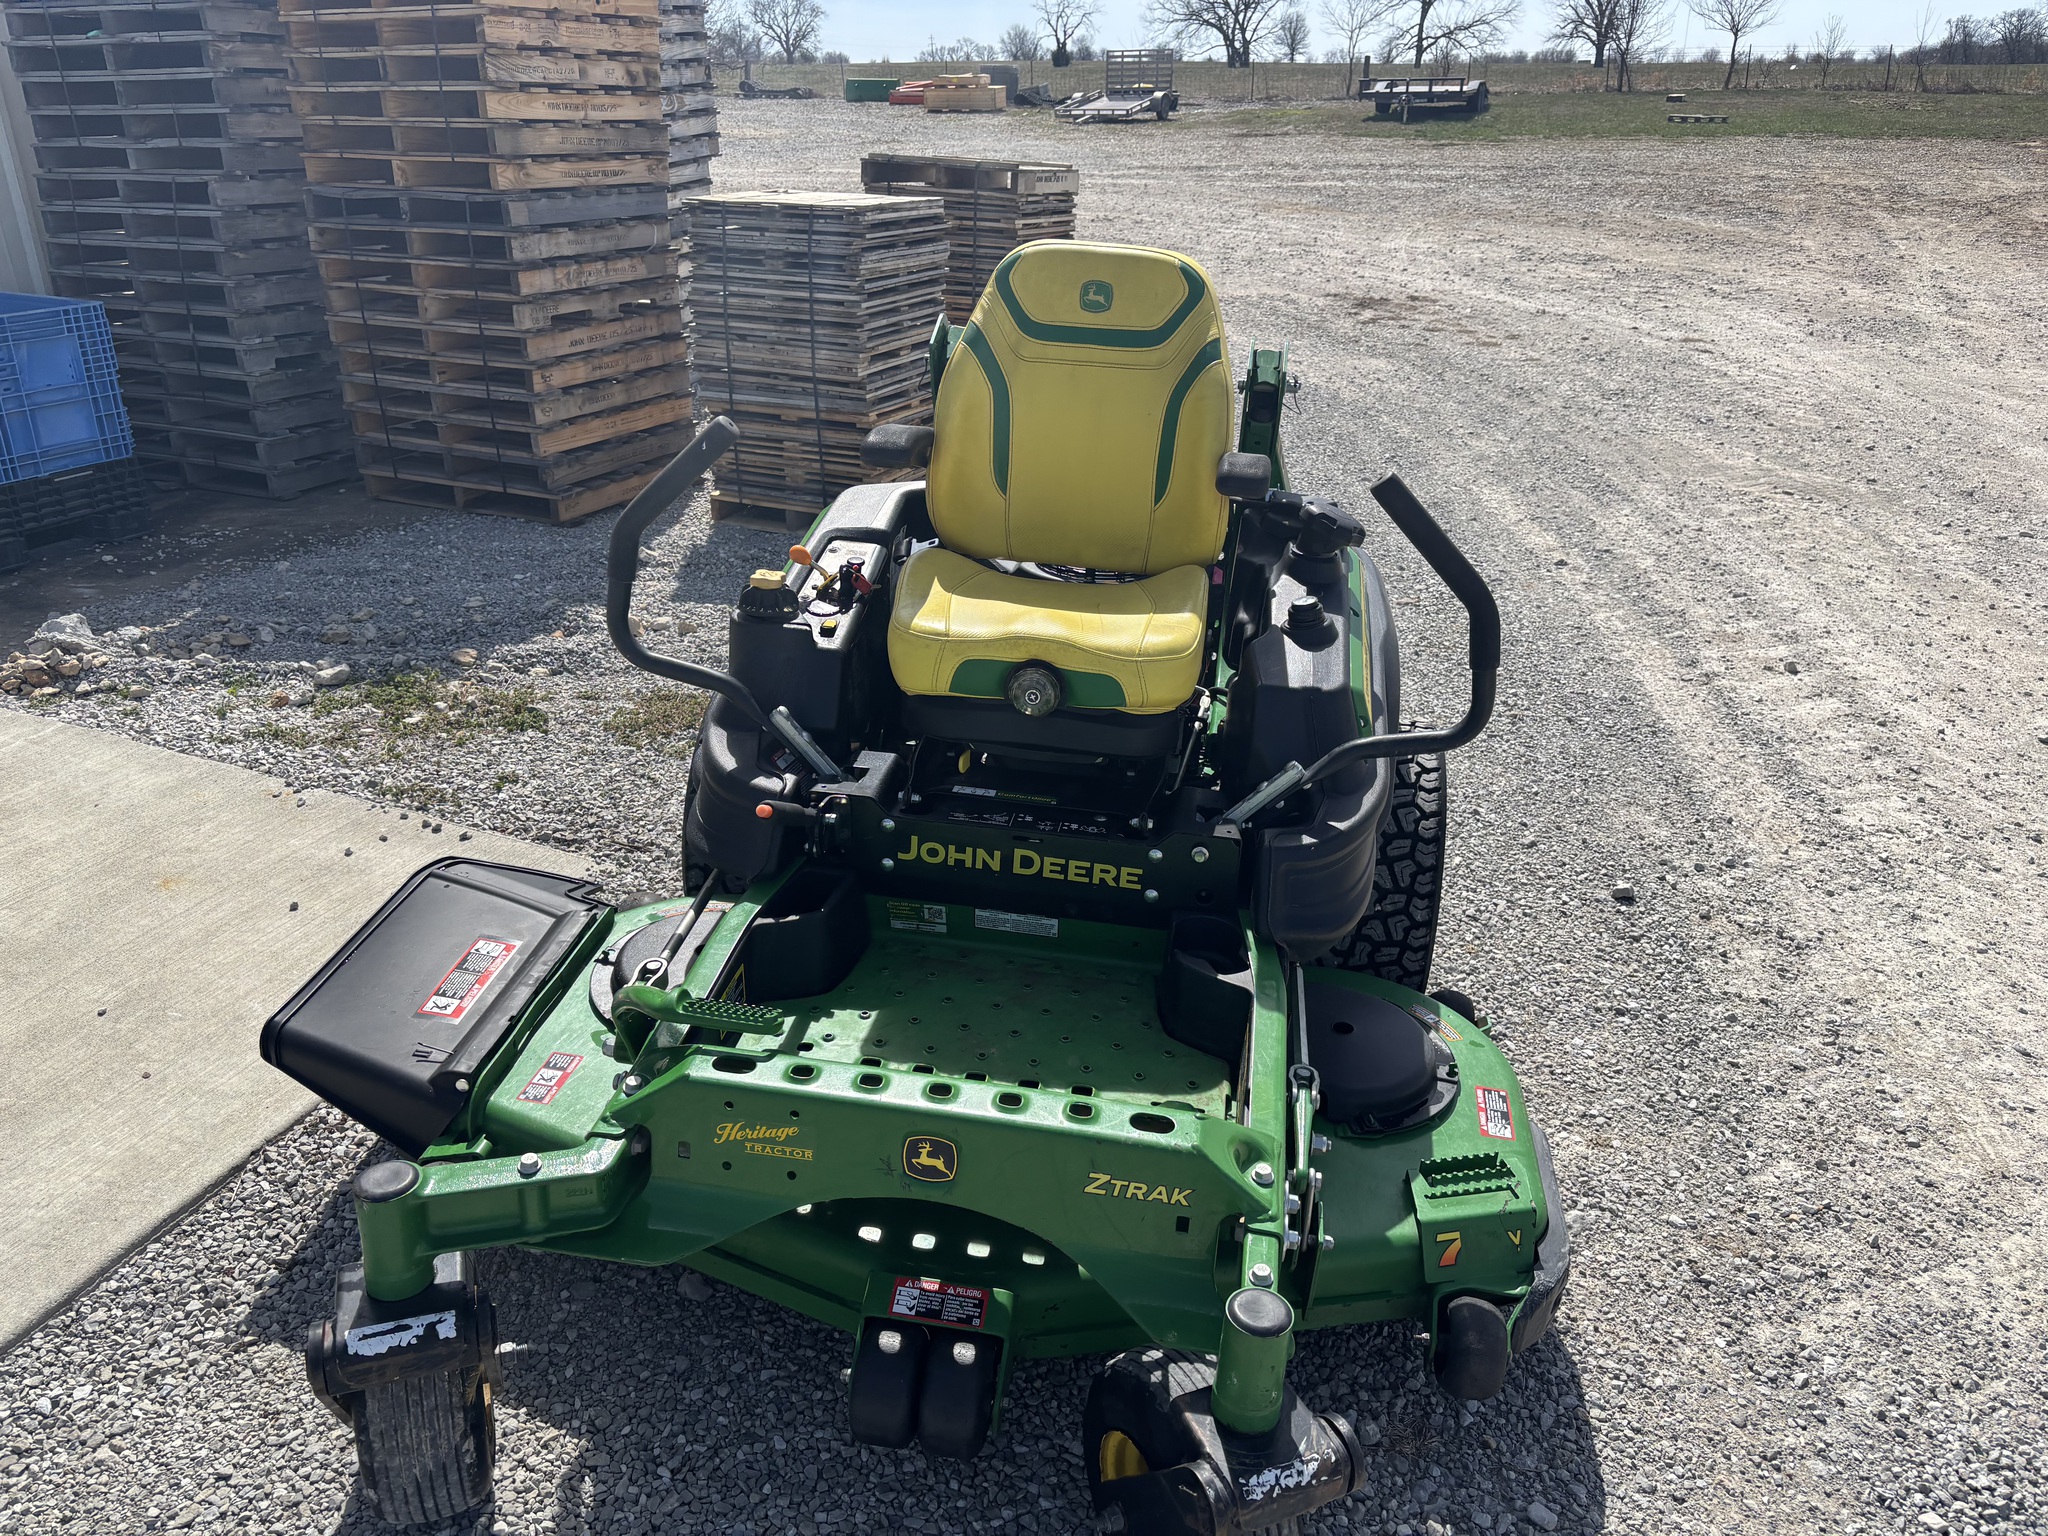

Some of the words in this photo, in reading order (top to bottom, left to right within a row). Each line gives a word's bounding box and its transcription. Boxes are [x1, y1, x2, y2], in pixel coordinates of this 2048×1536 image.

[897, 835, 1001, 872] JOHN
[1012, 848, 1143, 890] DEERE
[714, 1121, 800, 1144] Heritage
[745, 1143, 813, 1159] TRACTOR
[1083, 1172, 1194, 1207] ZTRAK
[1435, 1230, 1462, 1268] 7
[914, 1281, 940, 1291] DANGER
[955, 1287, 982, 1298] PELIGRO
